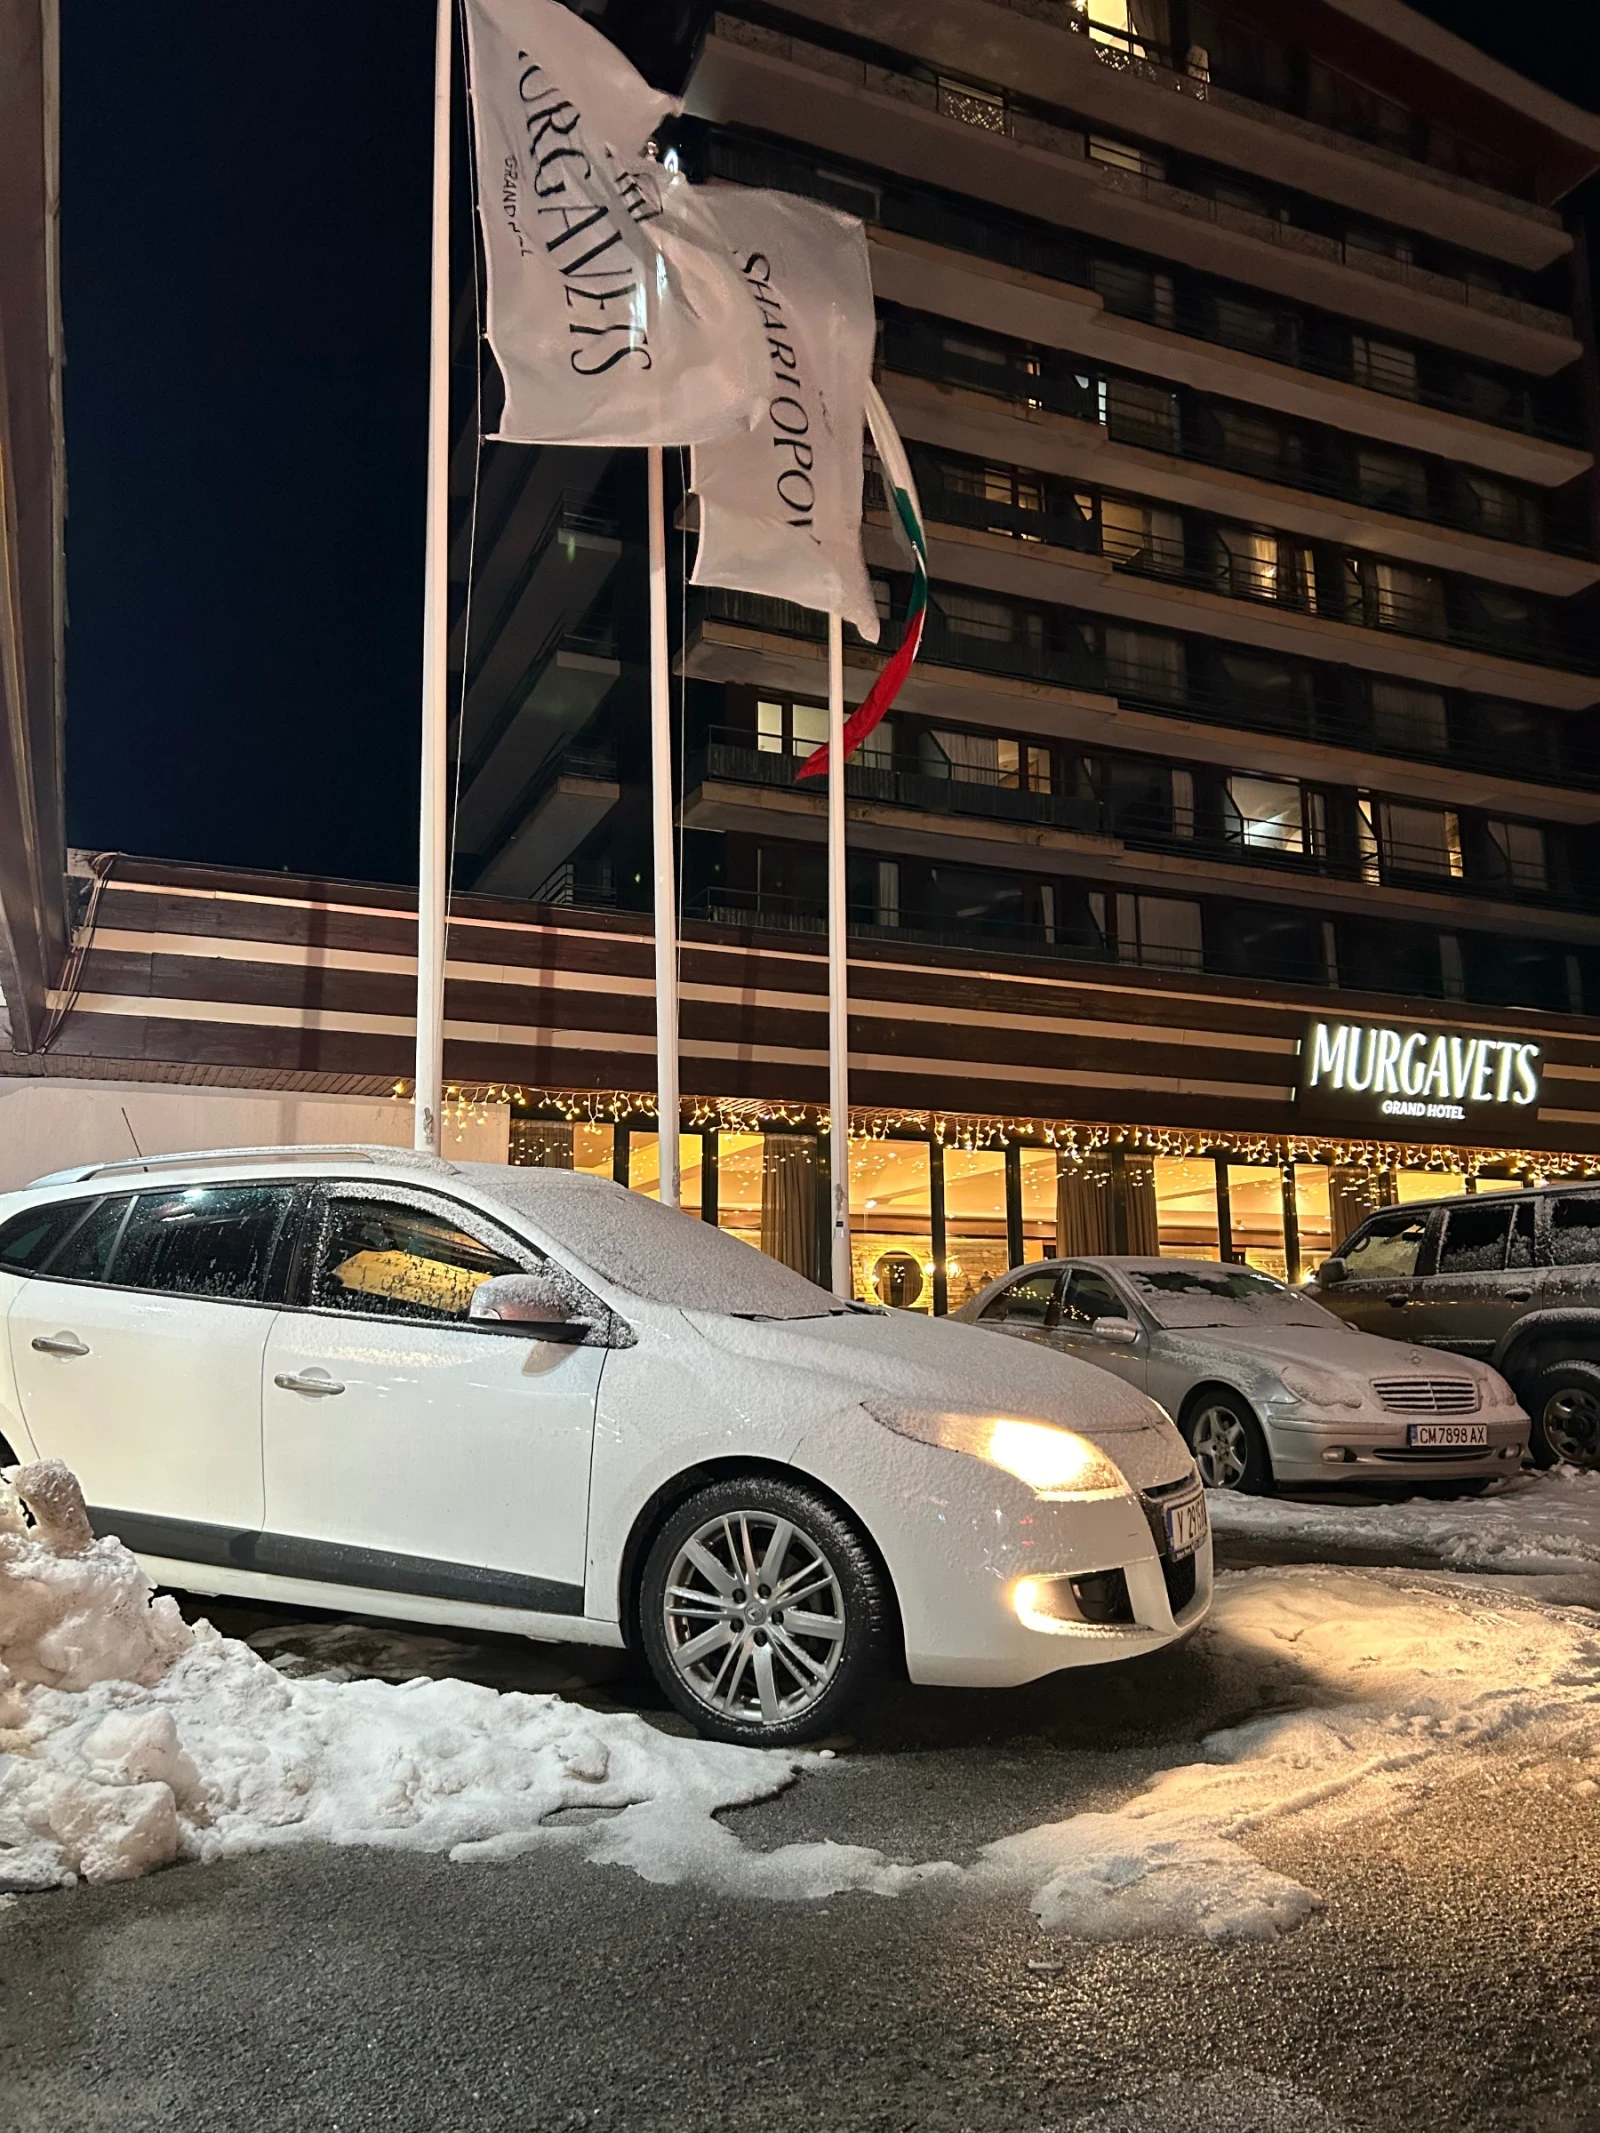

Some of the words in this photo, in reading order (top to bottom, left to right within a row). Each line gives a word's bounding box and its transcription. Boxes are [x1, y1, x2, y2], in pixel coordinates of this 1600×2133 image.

[502, 155, 518, 218] GRAND
[519, 50, 653, 376] URGAVETS
[1309, 1022, 1540, 1105] MURGAVETS
[1382, 1100, 1426, 1117] GRAND
[1427, 1103, 1466, 1120] HOTEL
